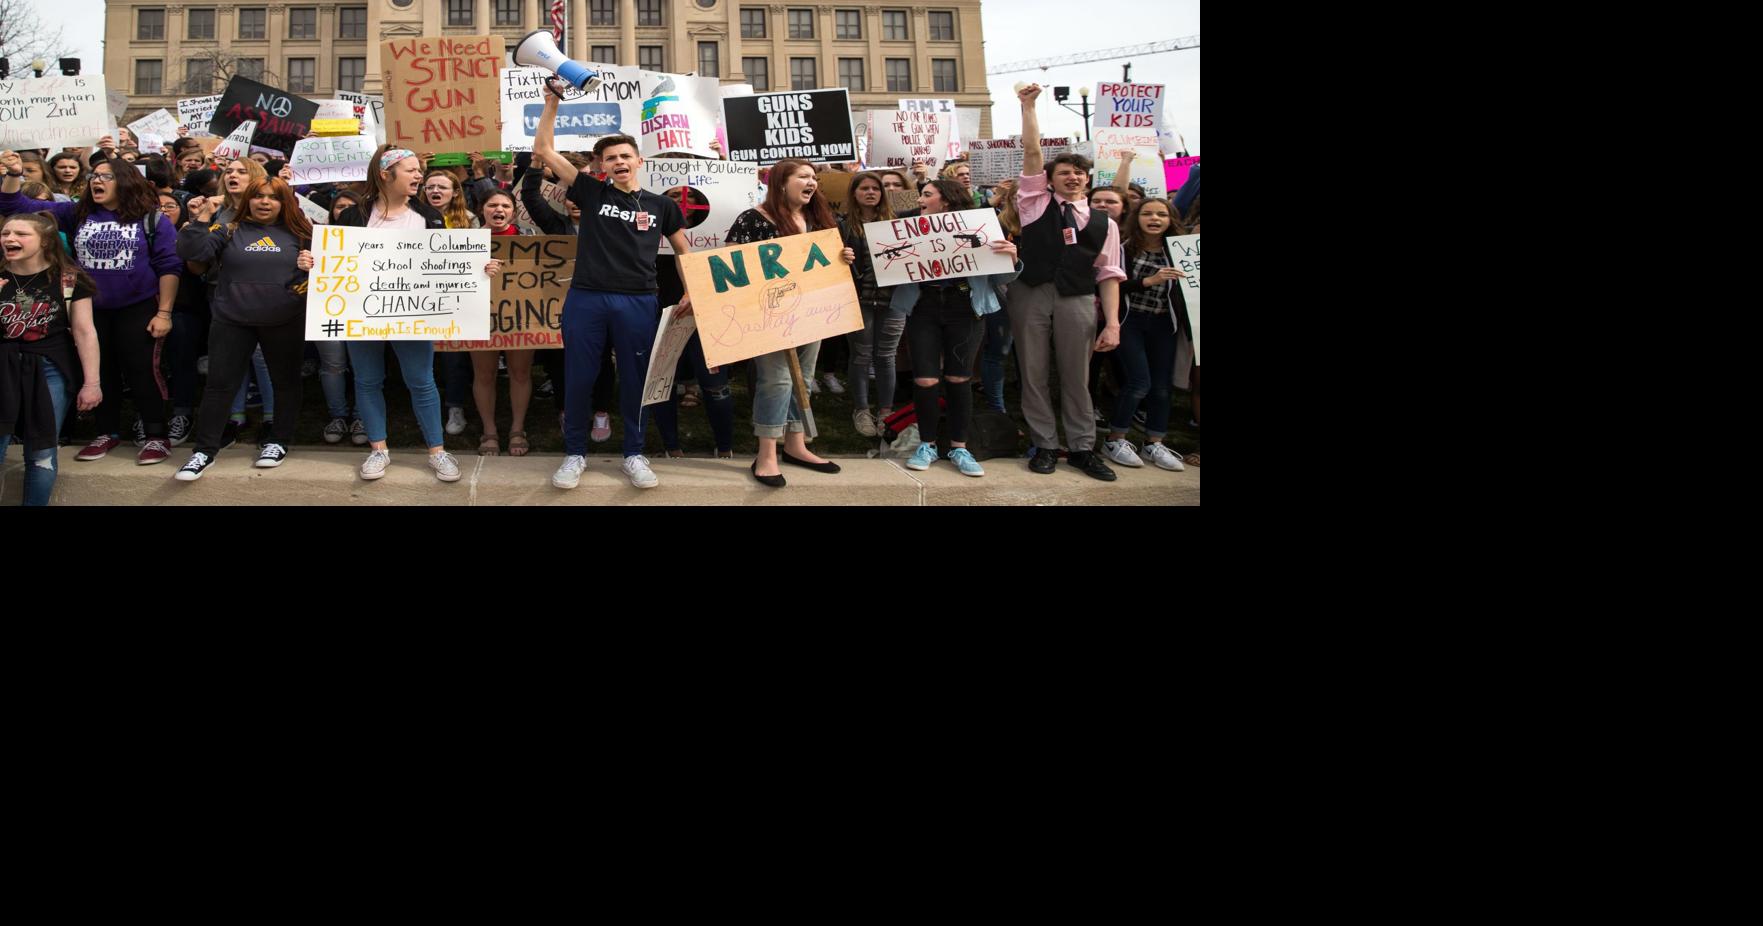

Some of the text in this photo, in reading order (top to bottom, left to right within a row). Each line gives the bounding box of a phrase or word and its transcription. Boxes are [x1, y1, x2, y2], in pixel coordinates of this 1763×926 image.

[389, 38, 491, 60] We Need
[405, 56, 500, 86] STRICT
[406, 87, 475, 112] GUN
[505, 87, 540, 101] forced
[603, 81, 641, 101] MOM
[1101, 83, 1164, 98] PROTECT
[0, 97, 24, 106] orth
[757, 93, 814, 113] GUNS
[907, 100, 951, 112] AM I
[1112, 97, 1154, 114] YOUR
[0, 102, 77, 123] our 2nd
[190, 112, 203, 121] MY
[766, 110, 809, 129] KILL
[1110, 113, 1153, 127] KIDS
[183, 121, 203, 131] NOT
[395, 115, 486, 143] LAWS
[228, 134, 249, 144] TROL
[656, 130, 693, 150] HATE
[765, 126, 815, 146] KIDS
[731, 143, 852, 161] GUN CONTROL NOW
[292, 165, 367, 181] NOT GUN
[644, 159, 701, 175] Thought
[726, 164, 756, 175] Were
[650, 173, 679, 187] Pro
[600, 204, 657, 228] RESIT.
[891, 212, 967, 240] ENOUGH
[322, 228, 487, 253] 19 years since Columbine
[684, 232, 720, 248] Next
[930, 238, 946, 253] IS
[320, 255, 358, 273] 175
[420, 259, 472, 275] shootings
[708, 242, 831, 293] NRA
[905, 253, 979, 282] ENOUGH
[316, 275, 360, 293] 578
[369, 276, 411, 291] deaths
[435, 280, 478, 293] injuries
[502, 271, 561, 291] FOR
